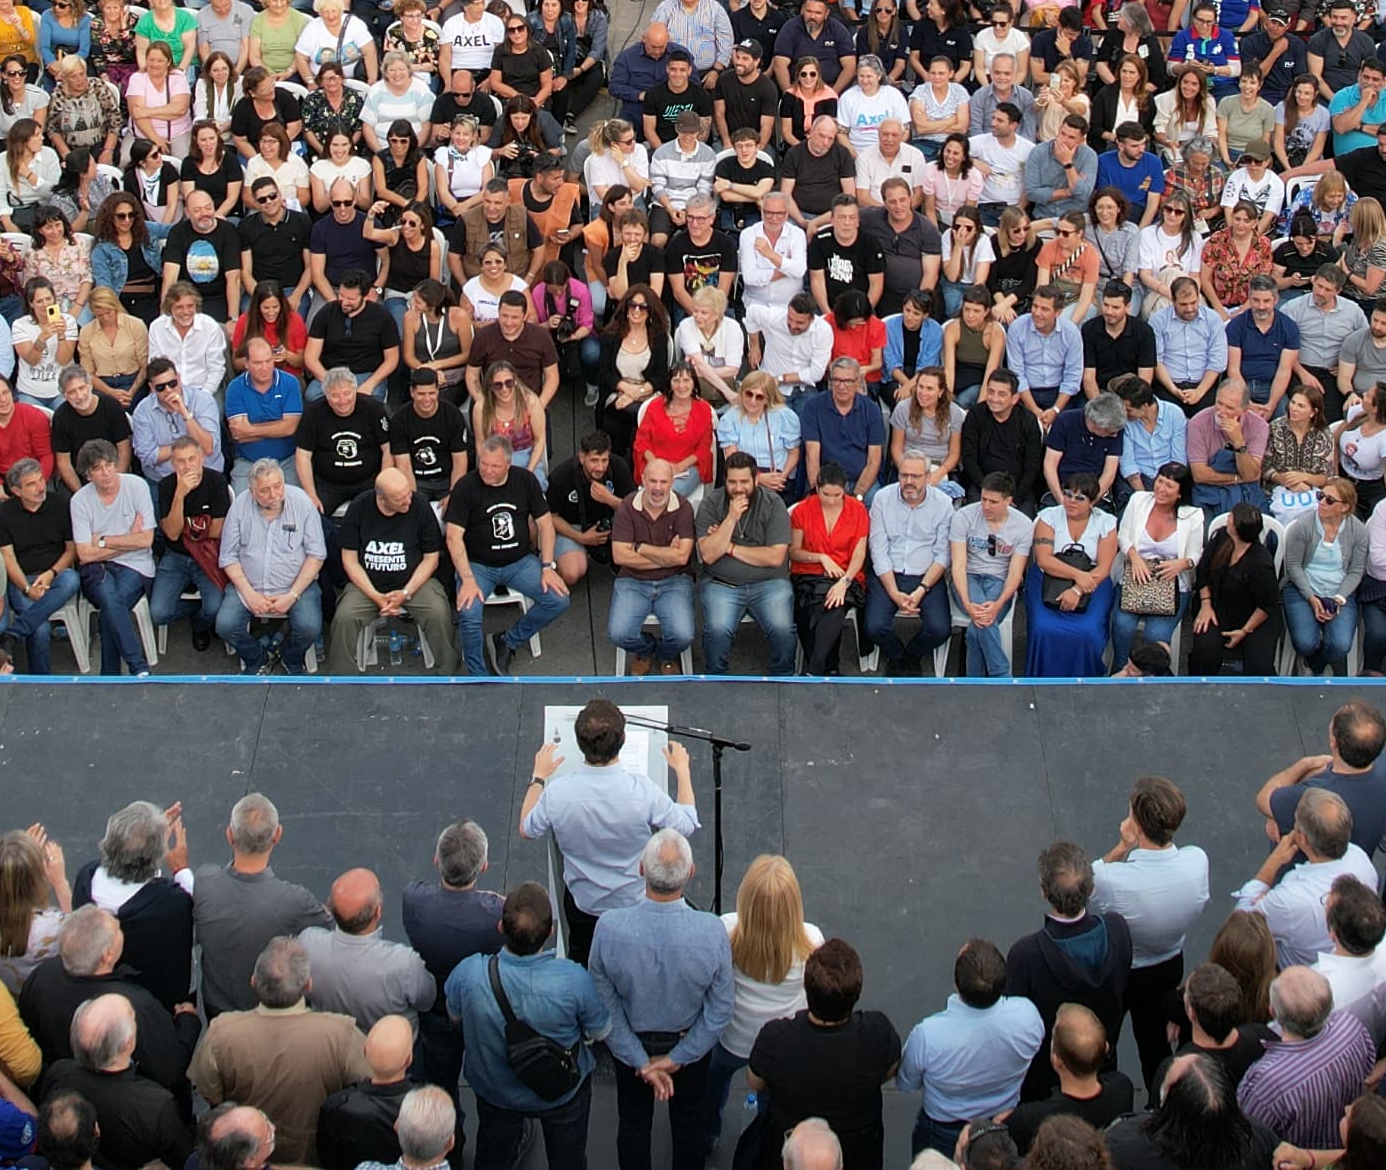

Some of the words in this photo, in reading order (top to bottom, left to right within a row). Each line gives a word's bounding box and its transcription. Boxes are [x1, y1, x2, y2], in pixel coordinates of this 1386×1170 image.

[453, 34, 491, 47] AXEL
[366, 540, 405, 555] AXEL
[365, 554, 406, 564] PRESENTE
[370, 562, 407, 572] FUTURO
